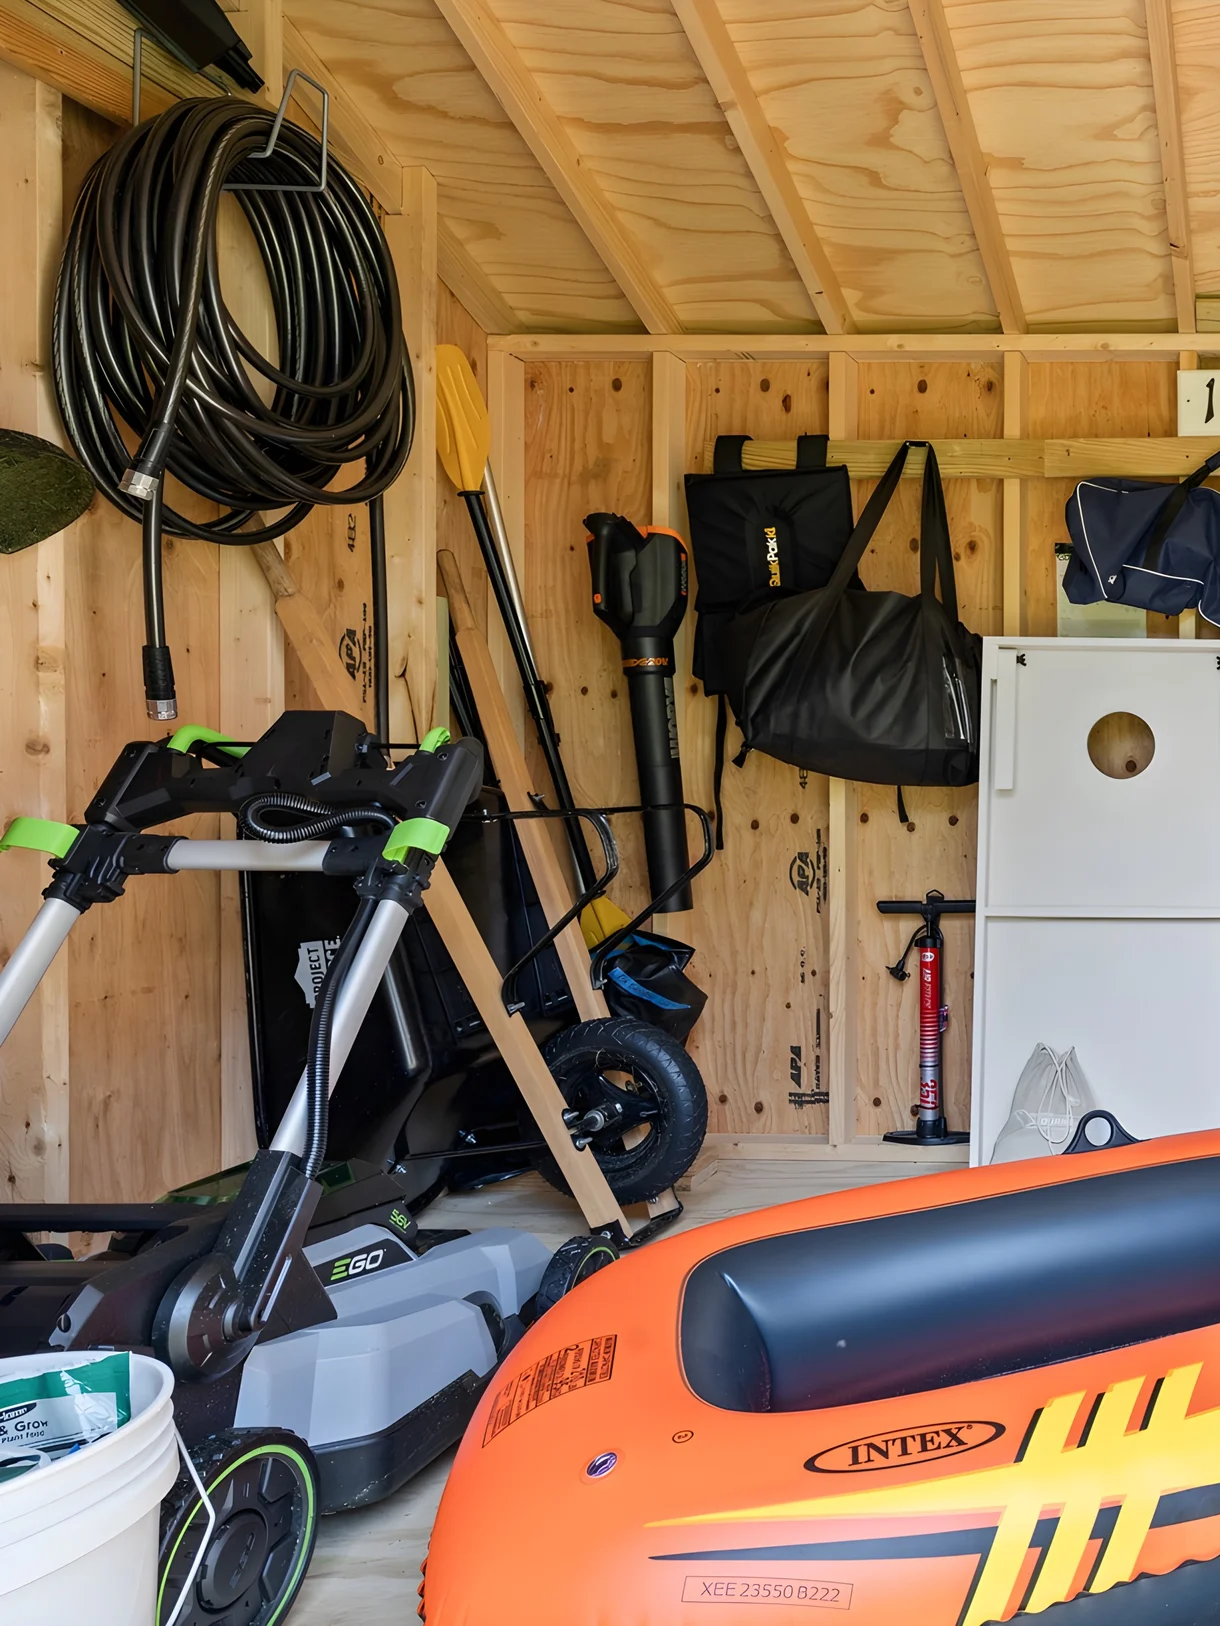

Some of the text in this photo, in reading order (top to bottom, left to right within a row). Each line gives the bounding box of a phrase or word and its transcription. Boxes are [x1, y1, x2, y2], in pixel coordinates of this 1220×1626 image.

[346, 628, 356, 681] APA
[797, 852, 809, 896] APA
[790, 1045, 801, 1089] APA
[330, 1249, 384, 1281] EGO
[14, 1420, 49, 1432] Grow
[847, 1425, 969, 1467] INTEX
[700, 1581, 738, 1597] XEE
[739, 1582, 795, 1599] 23550
